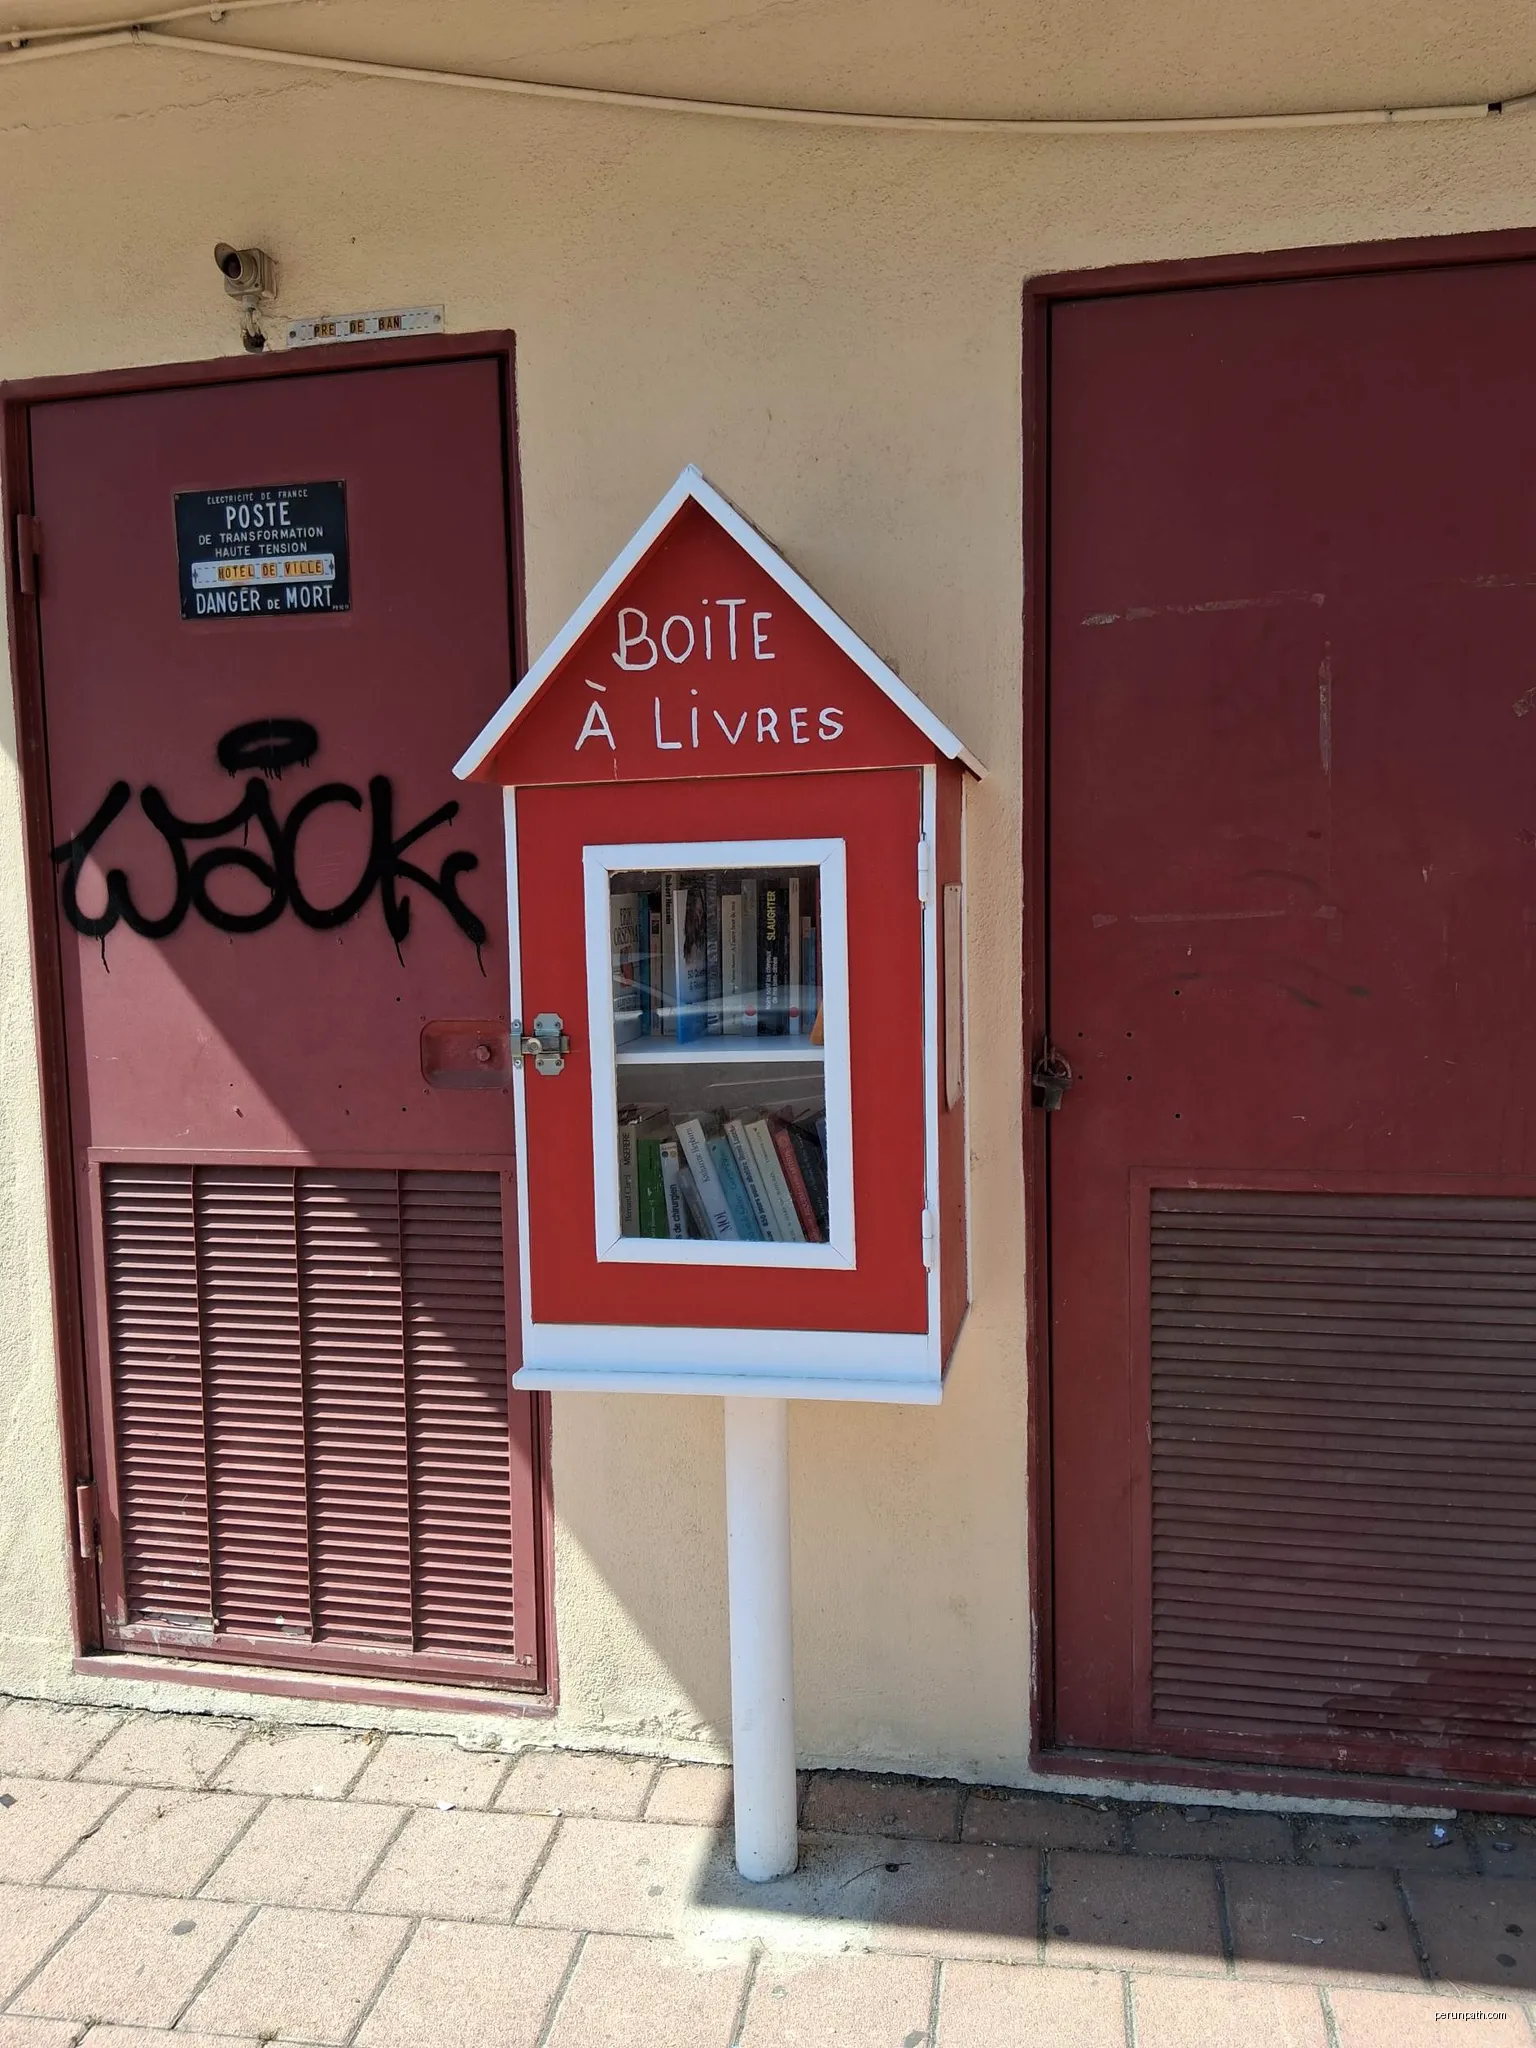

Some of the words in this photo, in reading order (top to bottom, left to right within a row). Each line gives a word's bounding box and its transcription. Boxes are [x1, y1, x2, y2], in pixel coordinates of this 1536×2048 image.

[314, 323, 336, 337] PRE
[350, 319, 365, 334] DE
[378, 315, 401, 329] BAN
[261, 491, 271, 500] DE
[278, 489, 308, 498] FRANCE
[226, 502, 291, 529] POSTE
[199, 535, 212, 545] DE
[220, 527, 323, 543] TRANSFORMATION
[215, 546, 251, 558] HAUTE
[259, 542, 307, 555] TENSION
[218, 566, 254, 580] HOTEL
[262, 564, 276, 576] DE
[284, 560, 322, 575] VILLE
[196, 591, 261, 614] DANGER
[267, 599, 280, 610] DE
[286, 585, 333, 608] MORT
[575, 679, 616, 750] À
[766, 891, 776, 941] SLAUGHTER
[669, 1184, 680, 1221] chirurgien
[673, 1223, 682, 1232] de
[714, 1211, 731, 1233] MOI
